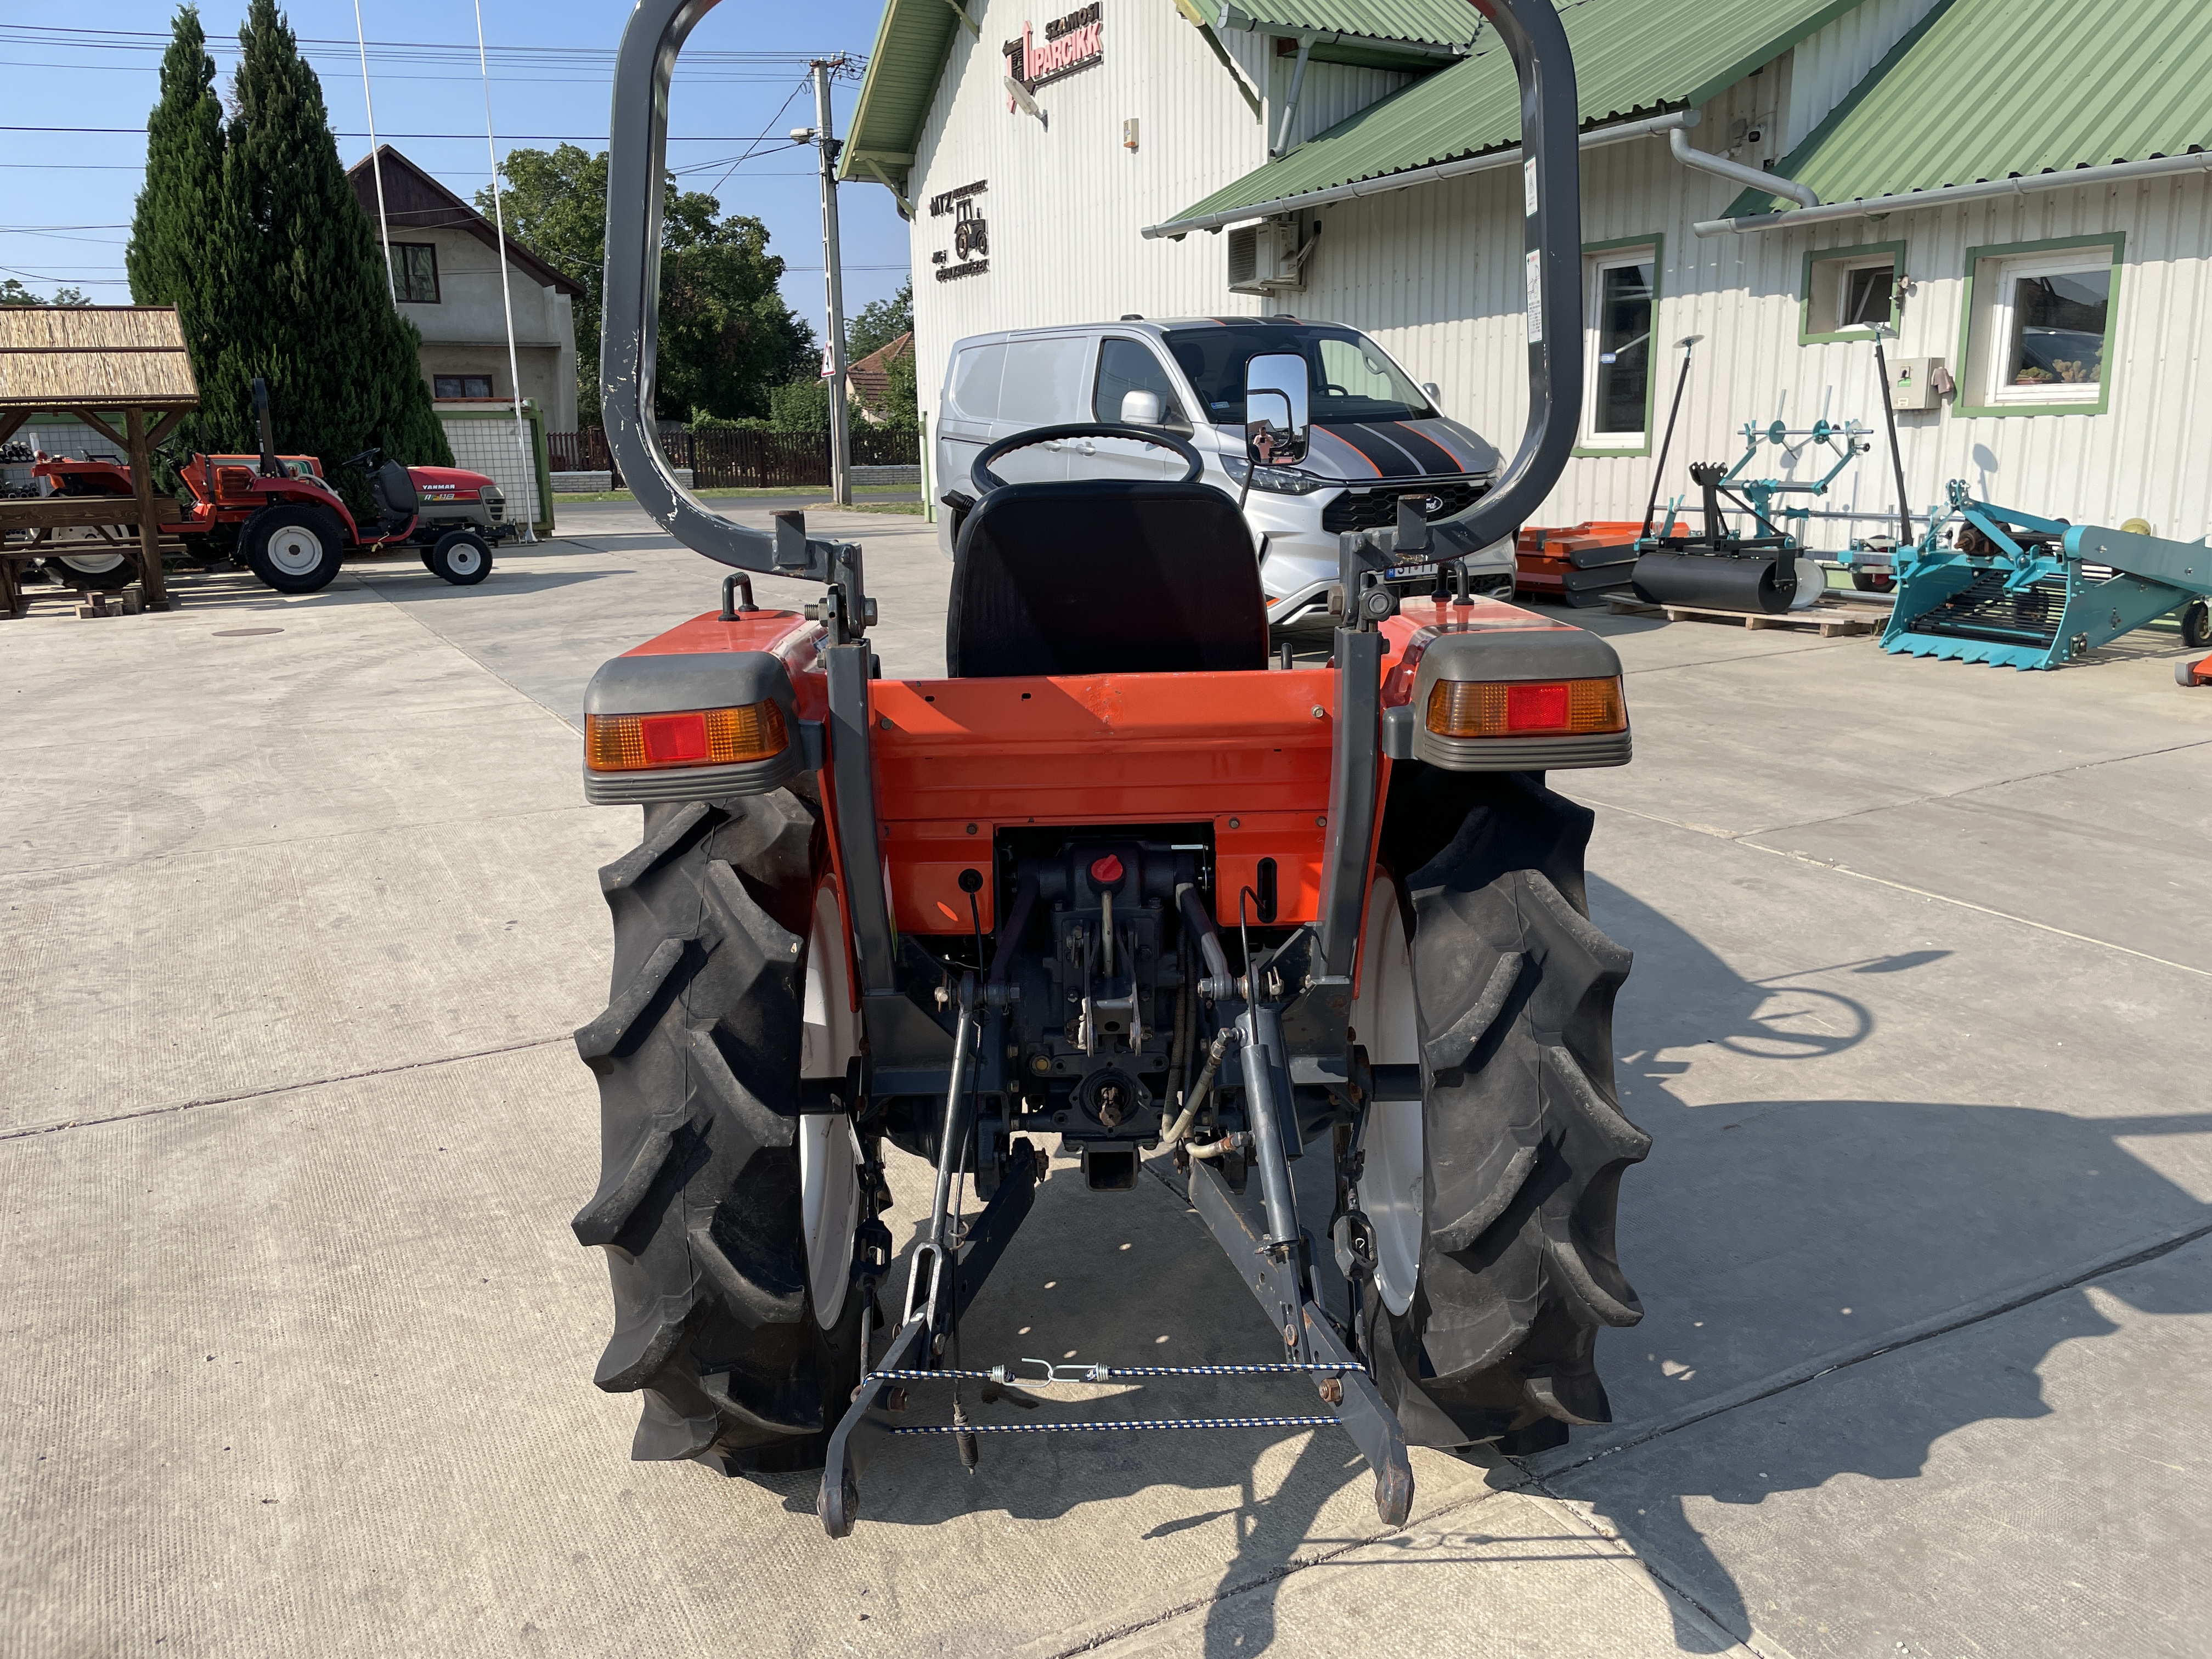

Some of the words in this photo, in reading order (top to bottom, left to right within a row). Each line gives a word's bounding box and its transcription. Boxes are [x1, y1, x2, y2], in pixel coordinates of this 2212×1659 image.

[1045, 1, 1100, 41] SZAMOSI
[1030, 21, 1102, 77] IPARCIKK
[930, 190, 954, 217] MTZ
